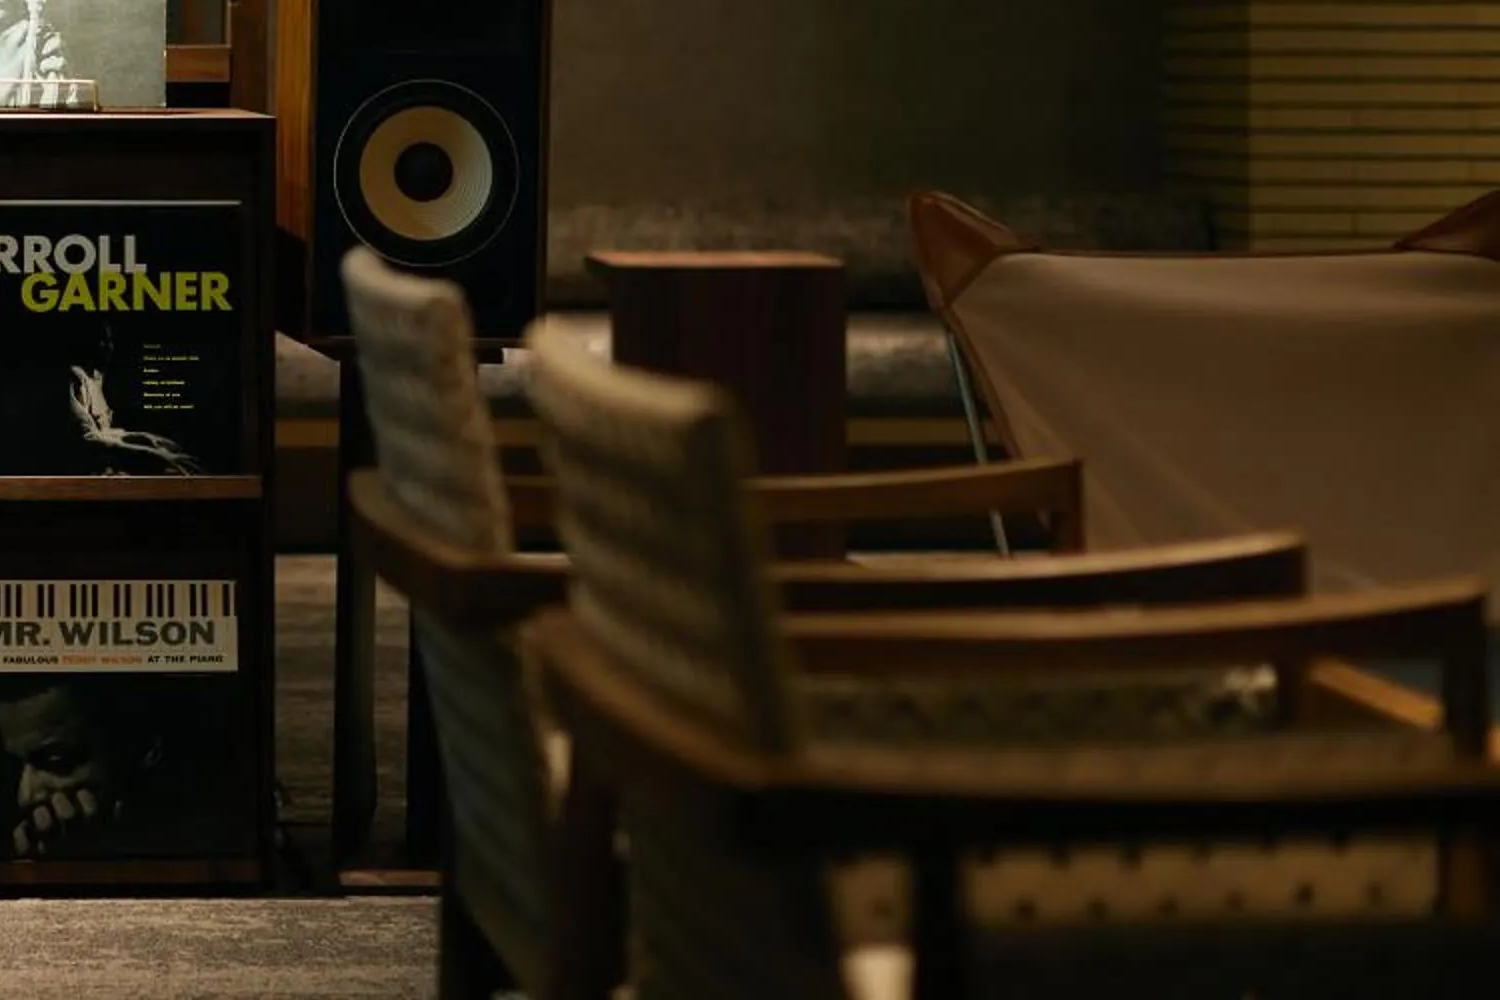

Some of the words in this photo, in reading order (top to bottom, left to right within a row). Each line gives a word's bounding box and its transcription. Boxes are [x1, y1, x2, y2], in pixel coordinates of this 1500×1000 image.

[20, 270, 233, 313] GARNER
[59, 620, 215, 646] WILSON
[148, 654, 161, 664] AT
[164, 654, 186, 664] THE
